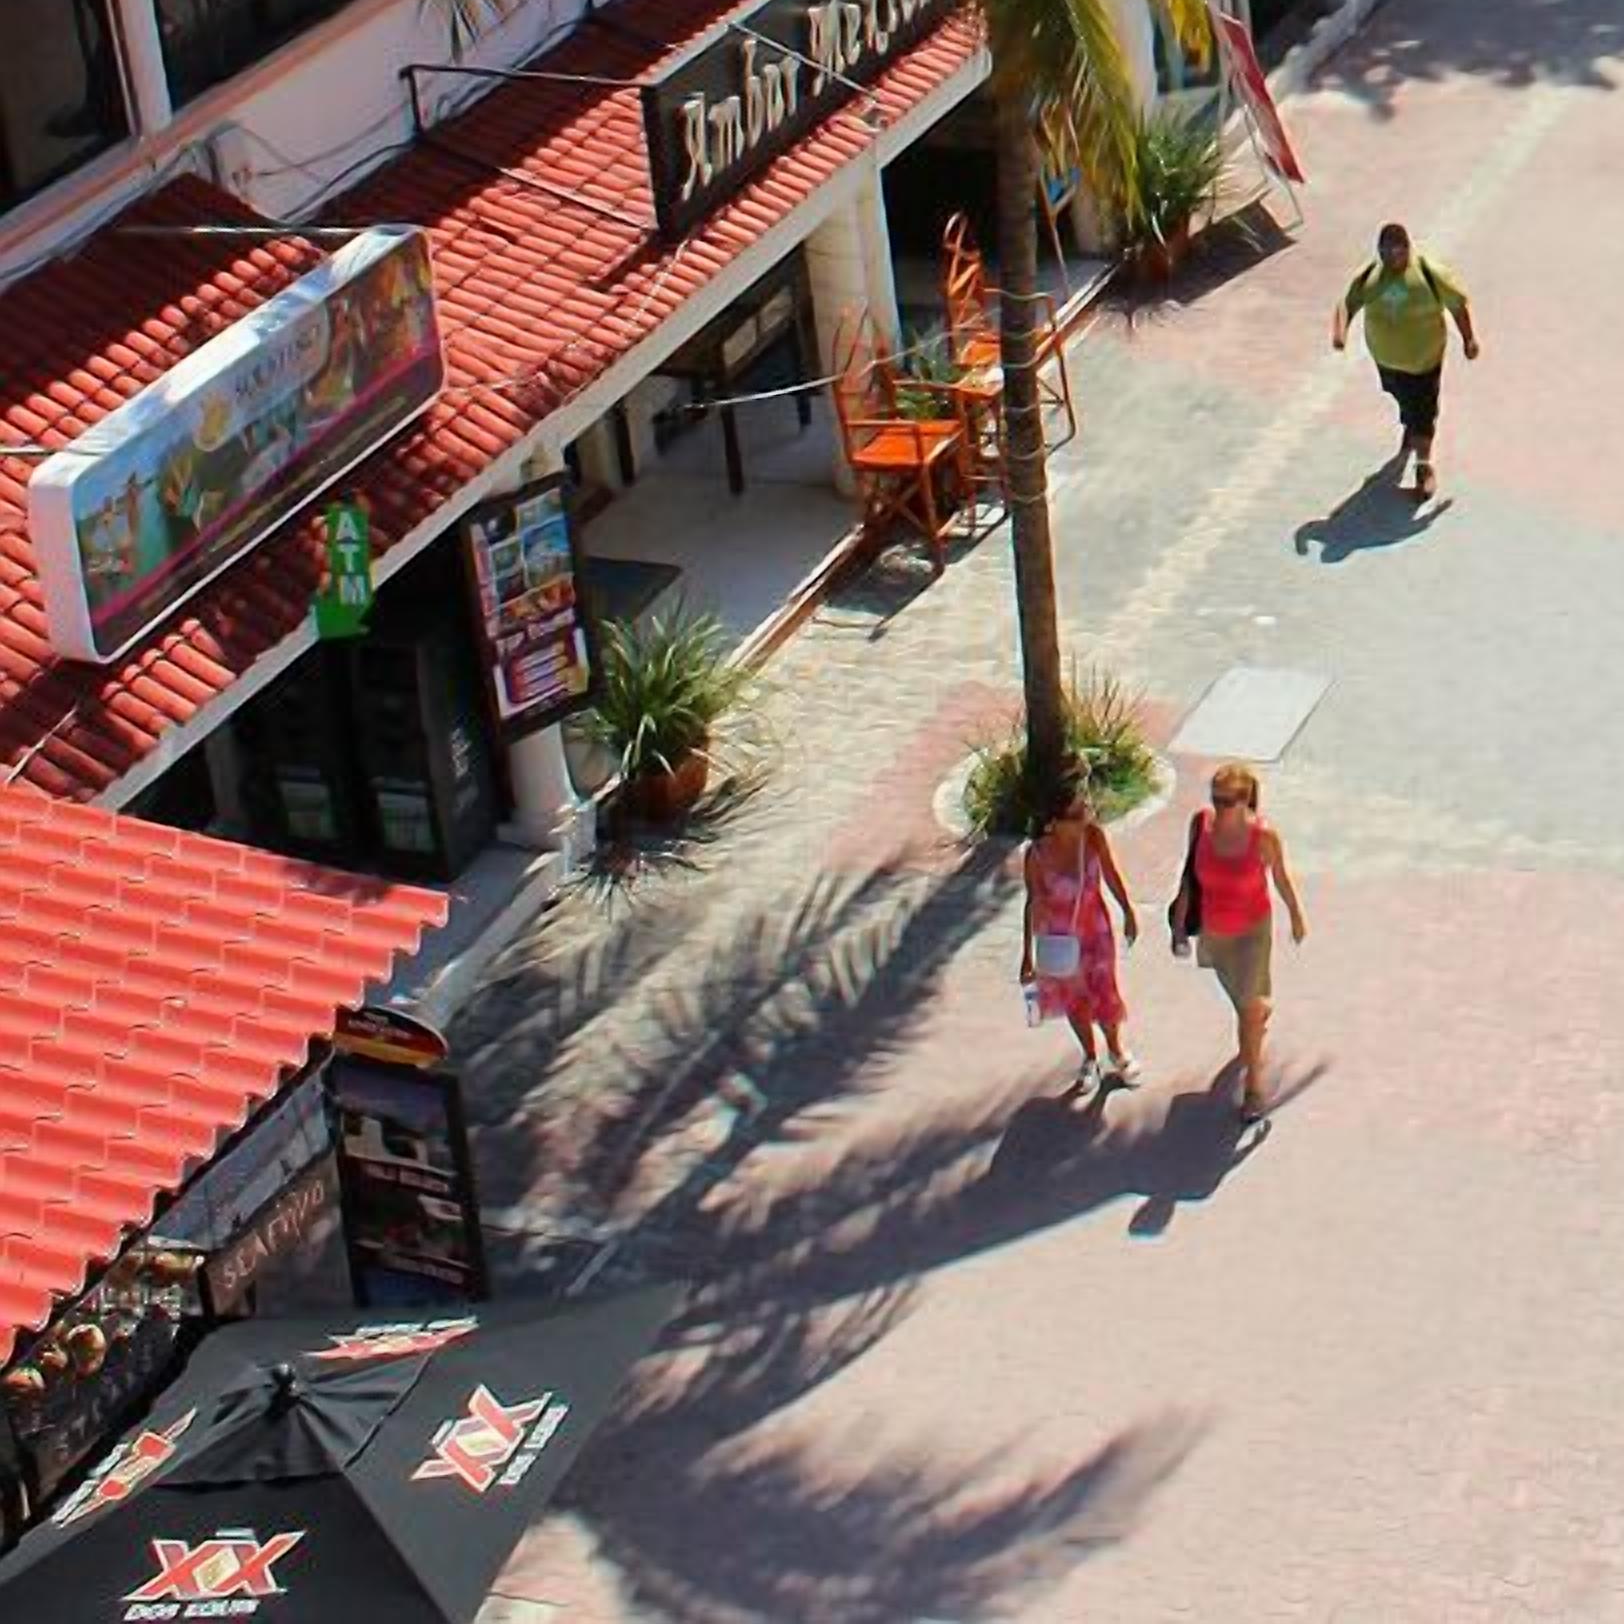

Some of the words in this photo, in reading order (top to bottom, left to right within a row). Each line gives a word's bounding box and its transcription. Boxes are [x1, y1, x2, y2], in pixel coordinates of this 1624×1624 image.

[679, 39, 801, 201] Ambar
[335, 510, 368, 605] ATM
[118, 1529, 307, 1601] XX
